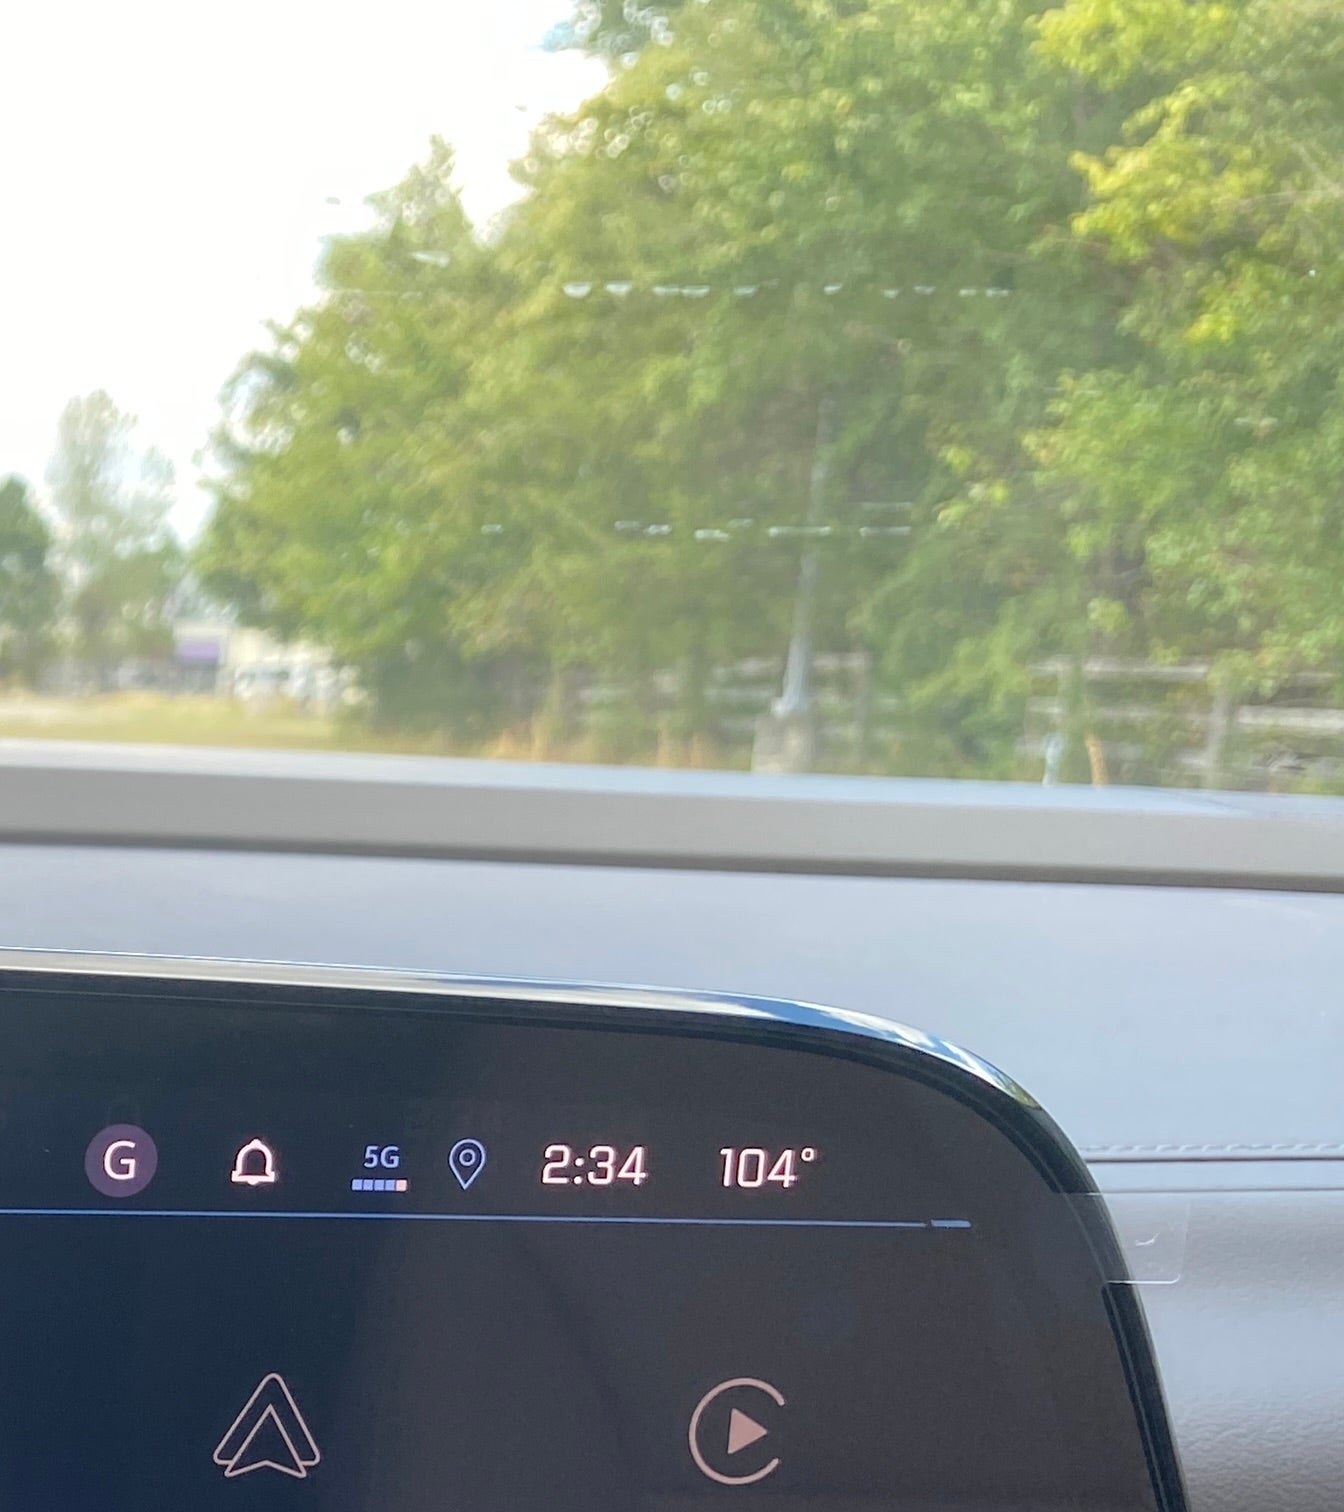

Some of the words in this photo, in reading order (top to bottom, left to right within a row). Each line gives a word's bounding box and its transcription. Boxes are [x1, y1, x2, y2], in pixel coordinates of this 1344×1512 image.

[104, 1140, 136, 1181] G
[363, 1145, 400, 1168] 5G
[542, 1144, 647, 1186] 2:34
